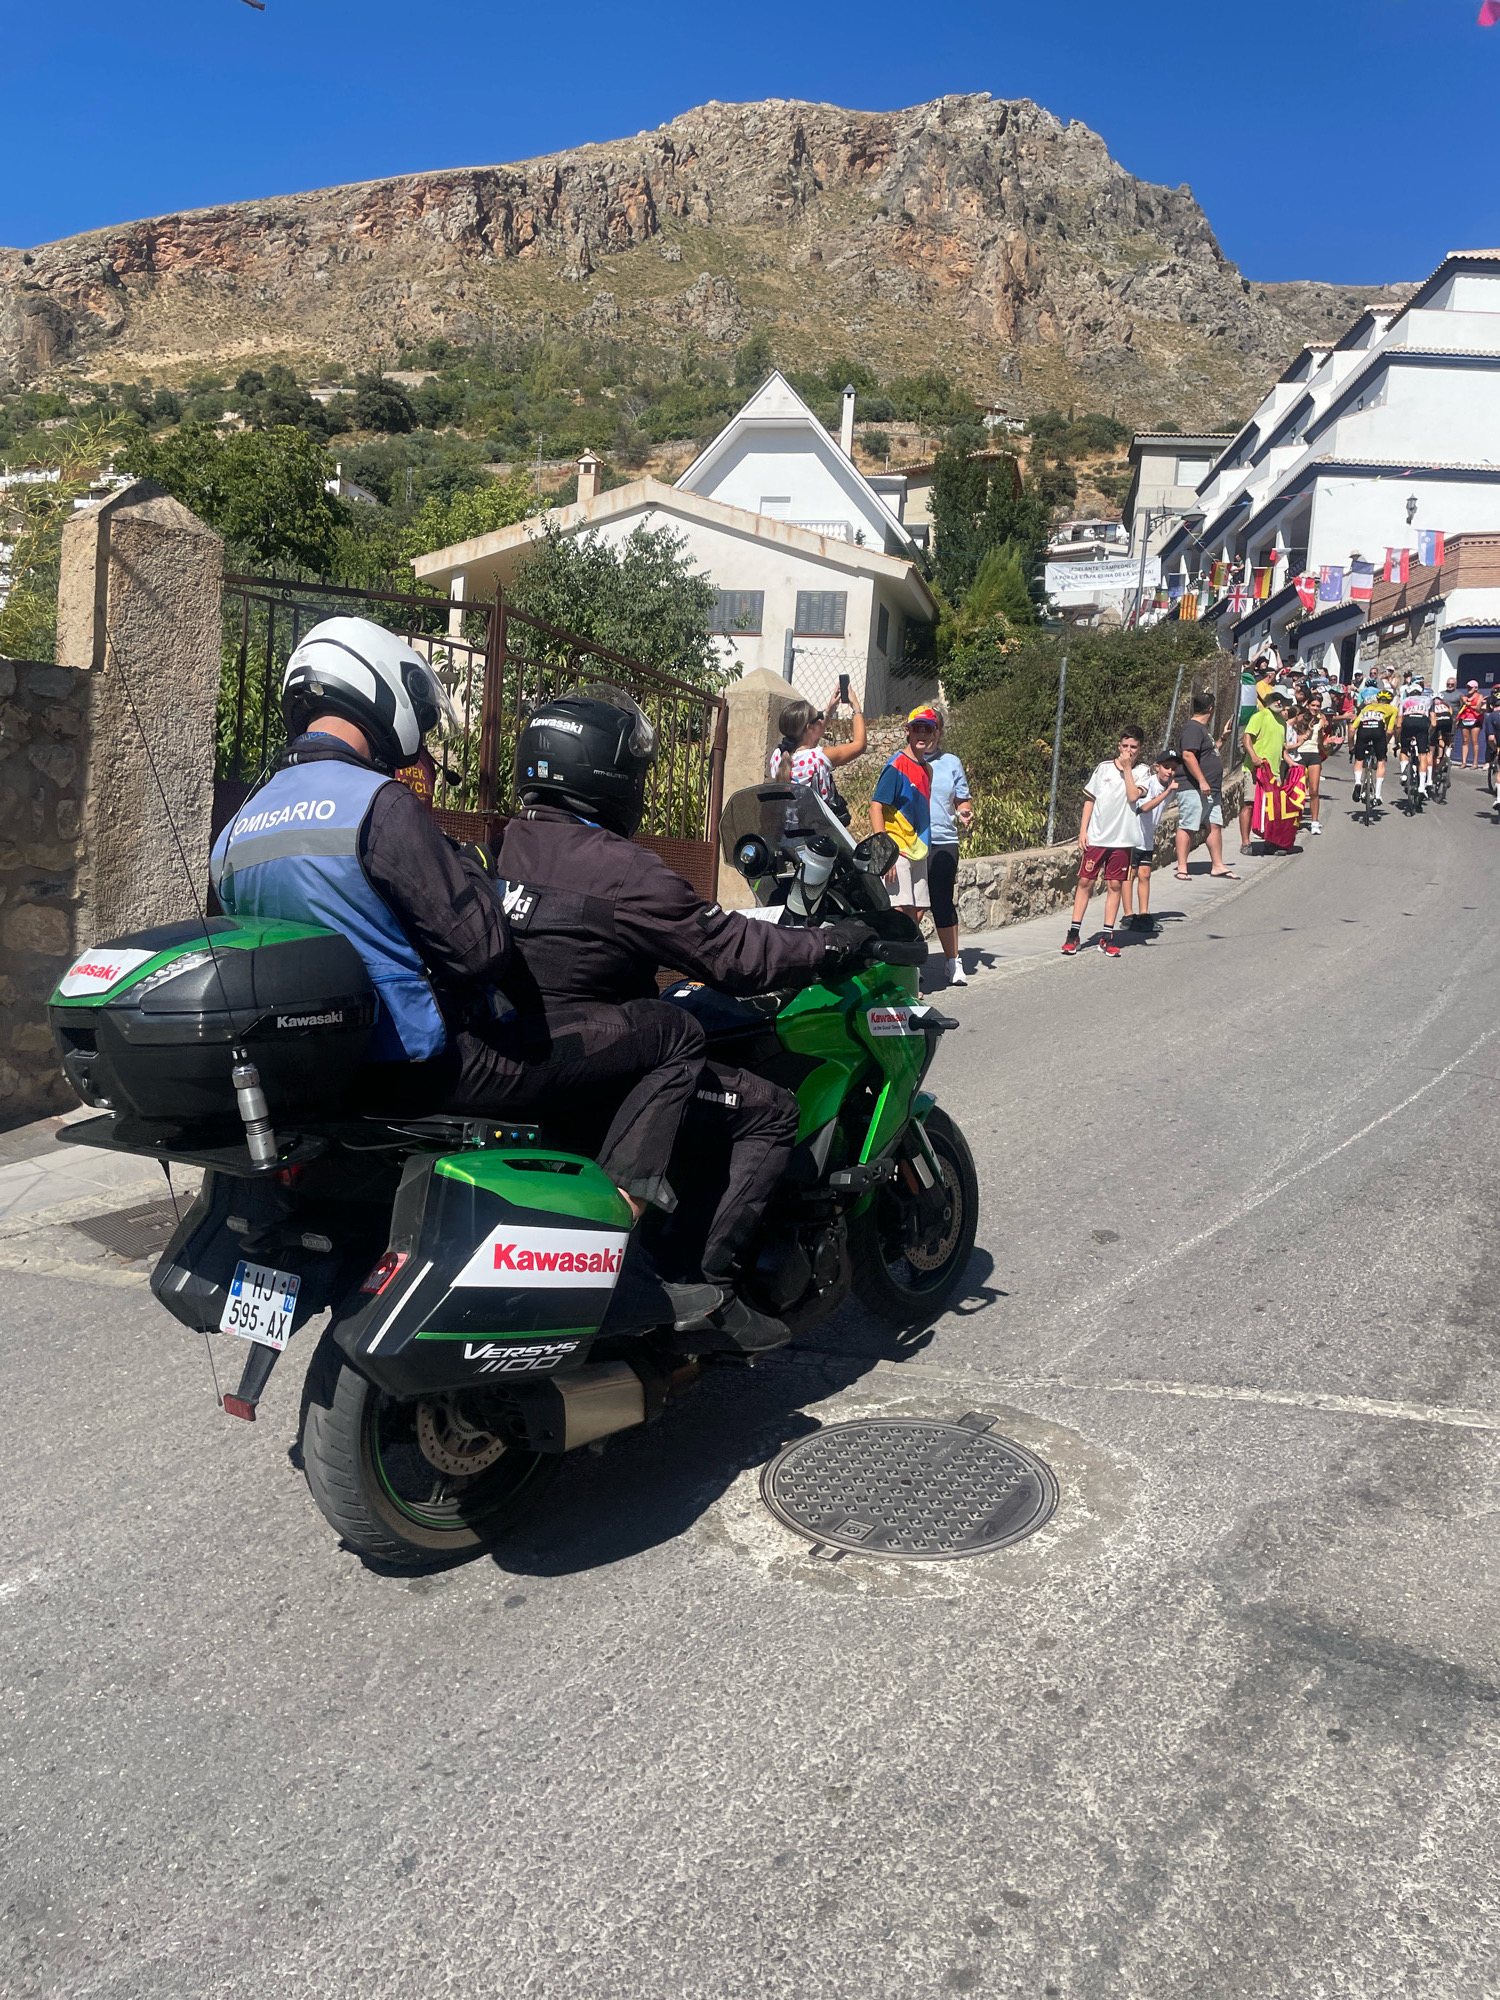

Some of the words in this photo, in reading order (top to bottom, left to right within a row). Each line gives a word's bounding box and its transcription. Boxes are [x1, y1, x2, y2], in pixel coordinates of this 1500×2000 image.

[530, 716, 584, 735] Kawasaki
[230, 799, 336, 840] OMISARIO
[276, 1010, 344, 1029] Kawasaki
[870, 1011, 908, 1024] Kawasaki
[493, 1243, 624, 1274] Kawasaki
[252, 1271, 277, 1302] HJ
[284, 1295, 294, 1311] 78
[464, 1340, 581, 1360] VERSYS
[472, 1355, 564, 1375] 1100
